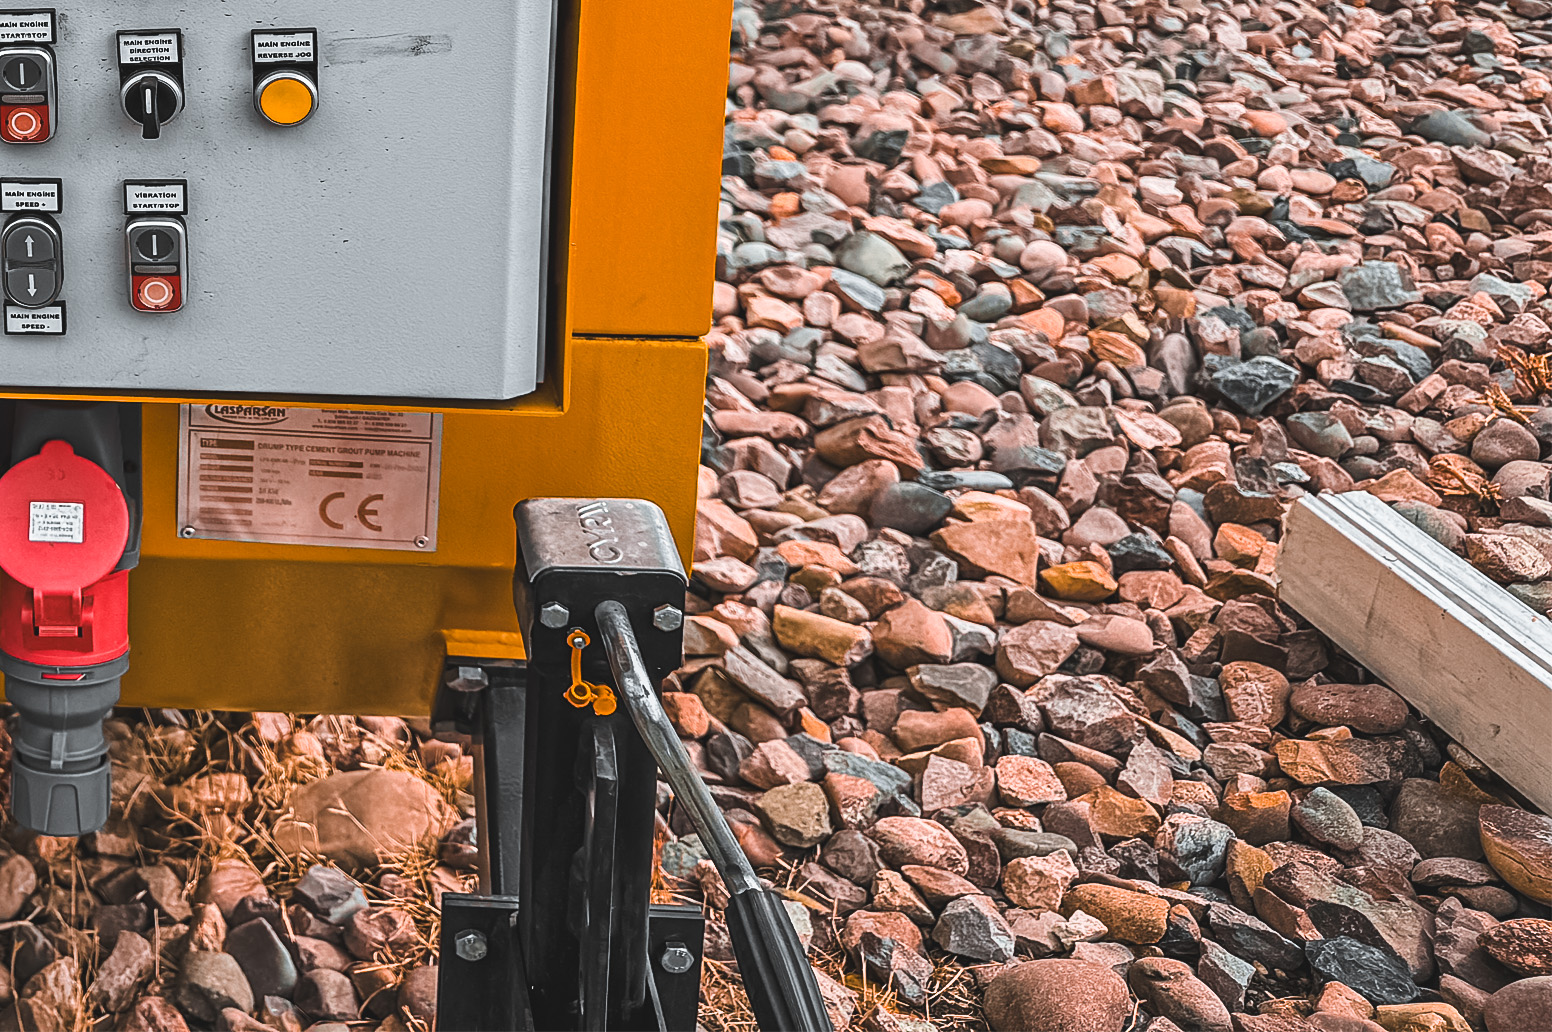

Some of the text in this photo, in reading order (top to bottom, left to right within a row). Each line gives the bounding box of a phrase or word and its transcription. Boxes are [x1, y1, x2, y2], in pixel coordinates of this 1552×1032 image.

[286, 444, 304, 452] TYPE
[305, 446, 336, 454] CEMENT
[336, 446, 363, 455] GROUT
[364, 448, 386, 456] PUMP
[386, 448, 421, 458] MACHINE
[318, 491, 384, 532] CE
